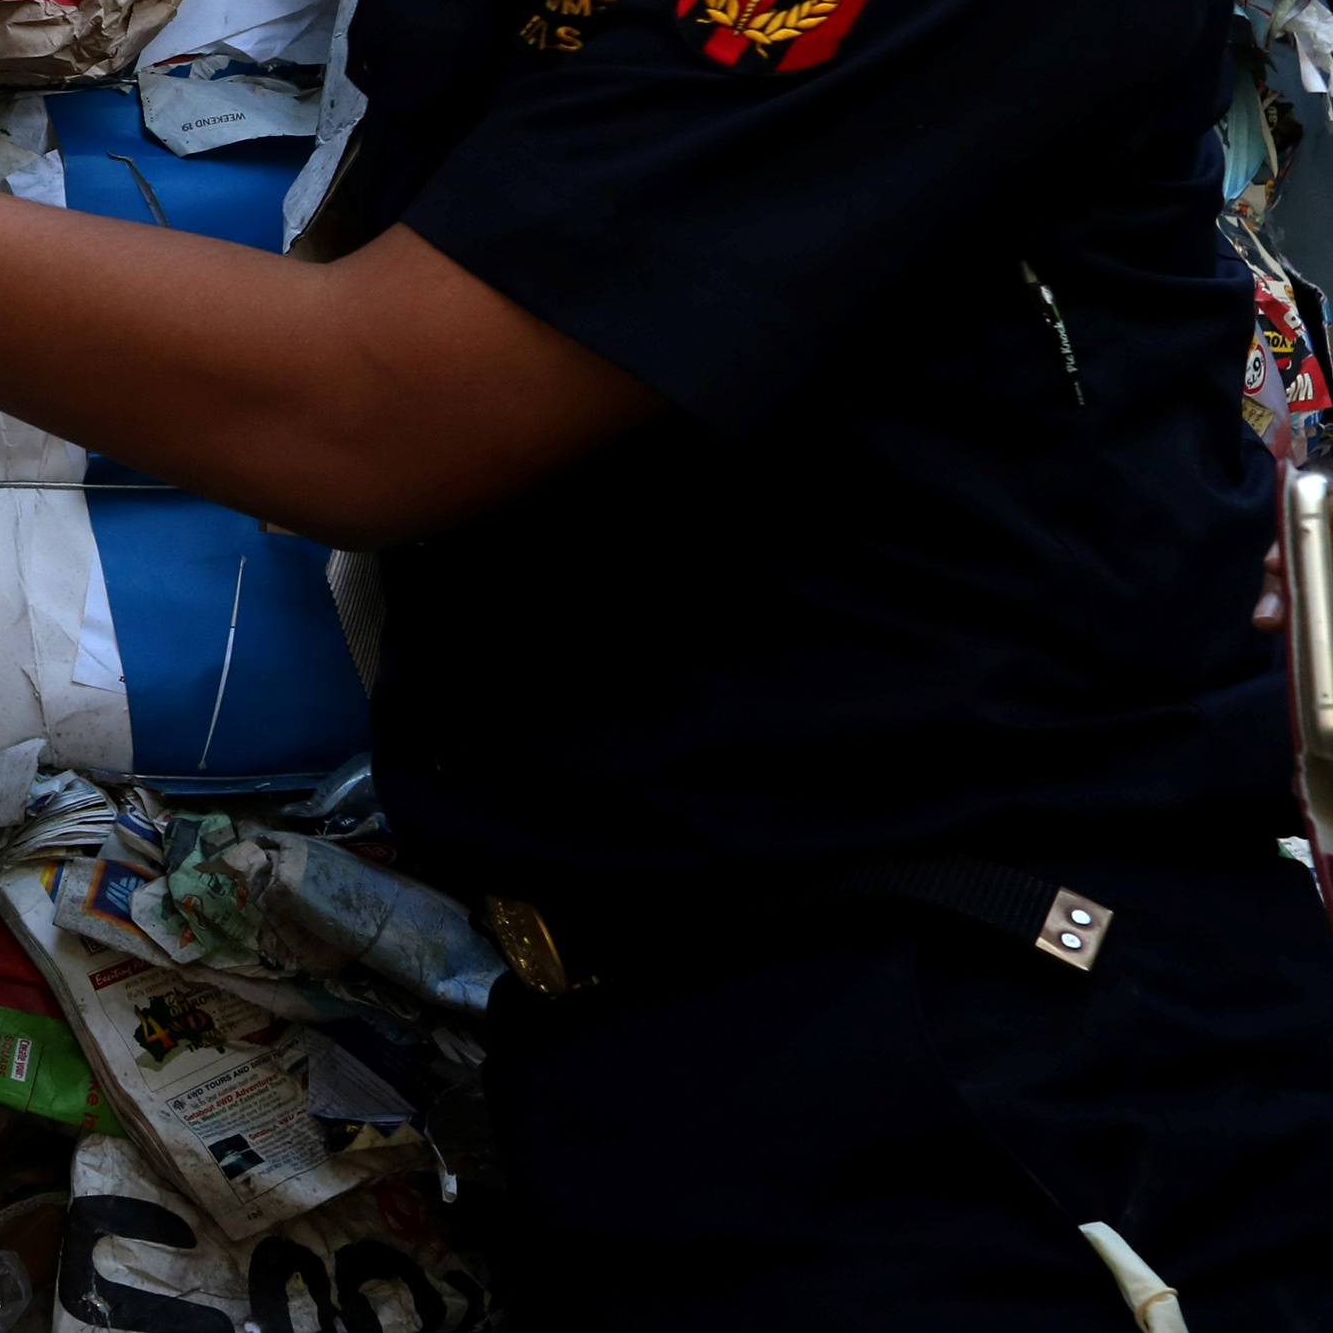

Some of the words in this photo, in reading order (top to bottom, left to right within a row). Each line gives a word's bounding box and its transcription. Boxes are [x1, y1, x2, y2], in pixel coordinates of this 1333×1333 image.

[203, 1075, 233, 1095] TOURS
[232, 1065, 250, 1081] AND
[216, 1097, 234, 1112] 4WD
[234, 1072, 279, 1102] Adventures
